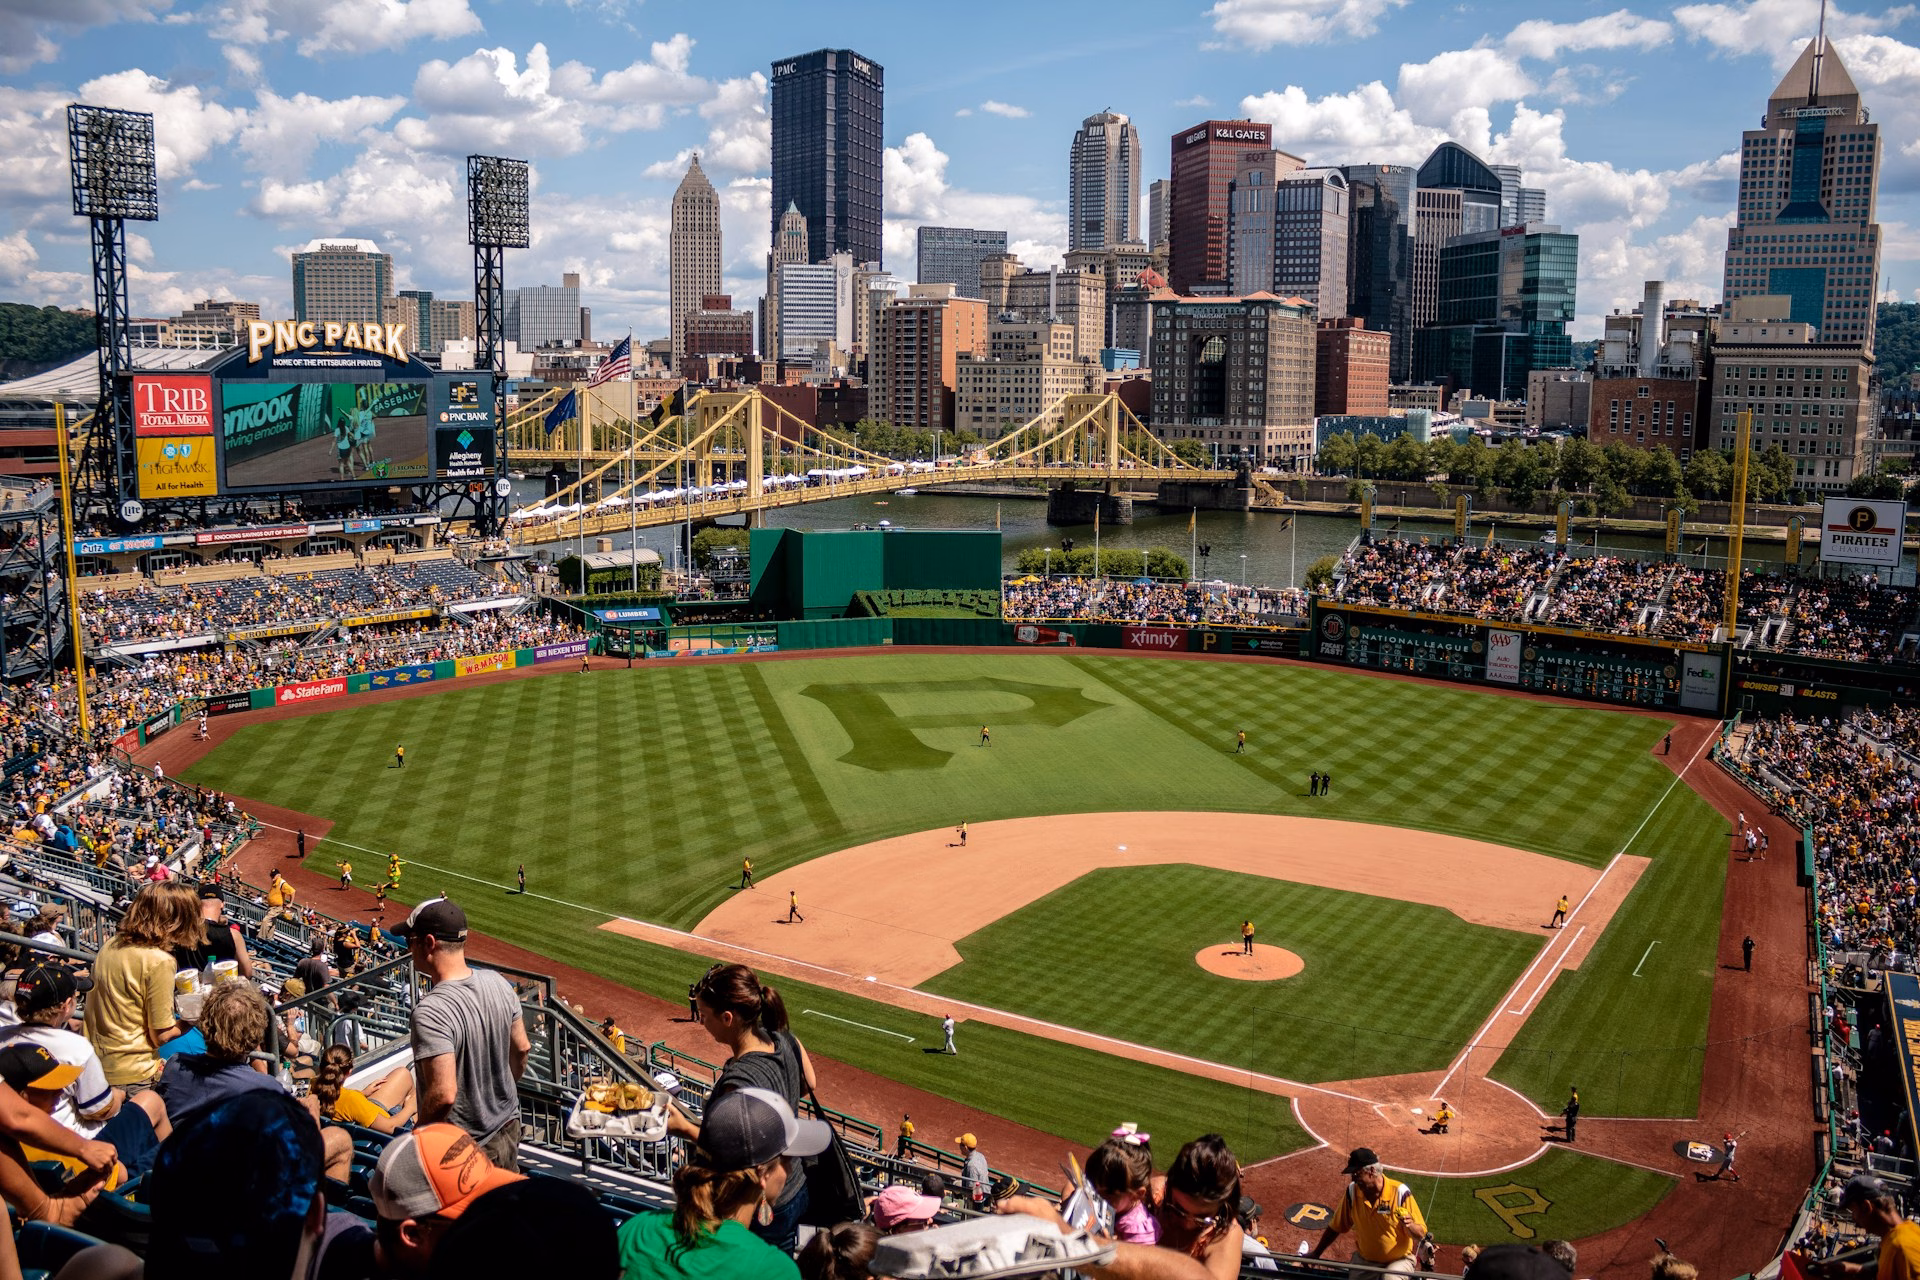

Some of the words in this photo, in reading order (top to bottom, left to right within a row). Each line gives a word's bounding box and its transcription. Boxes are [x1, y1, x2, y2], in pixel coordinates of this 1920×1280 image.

[853, 57, 871, 76] UPMC
[1193, 129, 1207, 142] GATES
[1216, 128, 1234, 138] K&L
[1235, 129, 1266, 140] GATES
[1245, 152, 1267, 162] EQT
[1390, 166, 1405, 174] PNC
[248, 320, 319, 363] PNC
[323, 321, 409, 364] PARK
[316, 359, 356, 367] PITTSBURGH
[357, 359, 382, 367] PIRATES
[138, 382, 208, 412] TRIB
[140, 414, 176, 426] TOTAL
[176, 414, 209, 426] MEDIA
[449, 412, 467, 421] PNC
[467, 412, 488, 421] BANK
[254, 420, 293, 441] emotion
[449, 452, 482, 460] Allegheny
[446, 469, 467, 477] Health
[475, 467, 485, 475] All
[156, 482, 167, 490] All
[167, 481, 178, 490] for
[180, 481, 204, 489] Health
[497, 483, 509, 492] Lite
[124, 505, 141, 517] Lite
[242, 530, 263, 538] SAVINGS
[1832, 534, 1888, 547] PIRATES
[1831, 545, 1888, 555] CHARITIES
[371, 614, 394, 623] LIGHT
[395, 611, 413, 620] BEER
[245, 630, 267, 638] IRON
[269, 627, 291, 636] CITY
[293, 624, 316, 633] BEER
[1131, 629, 1178, 648] xfinity
[1204, 632, 1217, 651] P
[1362, 633, 1420, 646] NATIONAL
[1424, 641, 1469, 653] LEAGUE
[548, 646, 570, 656] NEXEN
[571, 643, 586, 652] TIRE
[1488, 661, 1518, 669] Insurance
[1538, 655, 1605, 669] AMERICAN
[1609, 664, 1661, 677] LEAGUE
[1489, 672, 1517, 680] AAA.com
[1687, 667, 1715, 679] FedEx
[295, 681, 344, 698] StateFarm
[1743, 681, 1779, 692] BOWSER
[1803, 689, 1837, 700] BLASTS
[228, 701, 249, 709] SPORTS
[1290, 1203, 1329, 1223] P
[1473, 1181, 1553, 1239] P
